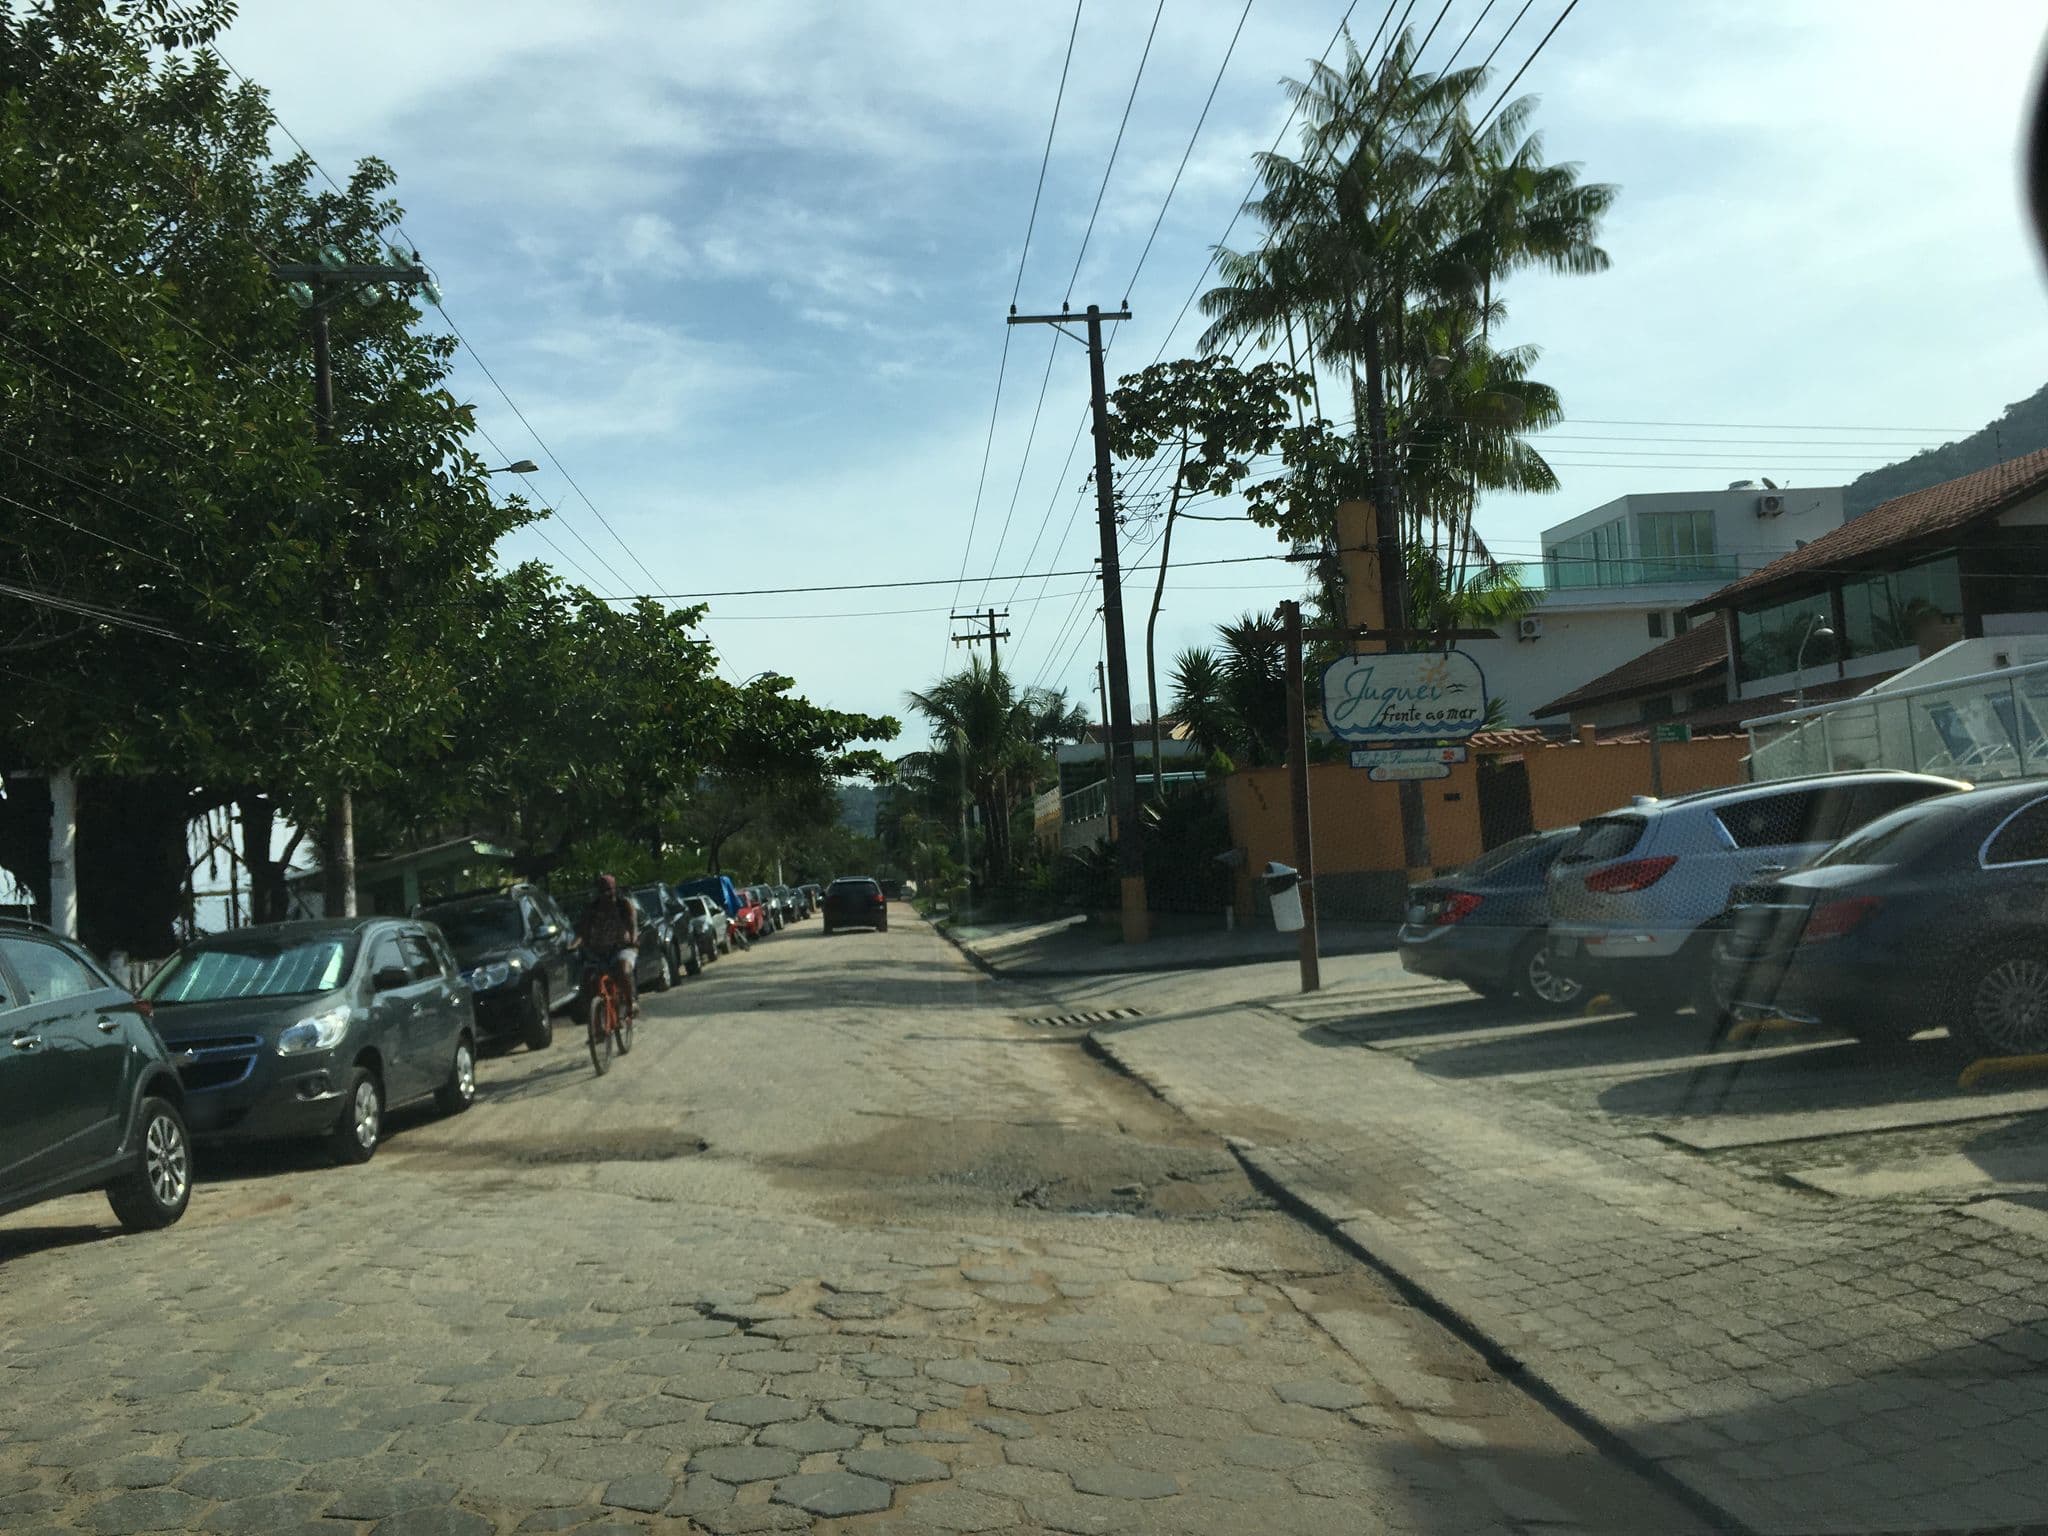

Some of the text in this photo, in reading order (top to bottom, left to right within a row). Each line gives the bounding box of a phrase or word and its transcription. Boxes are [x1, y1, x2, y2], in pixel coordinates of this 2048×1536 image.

[1380, 703, 1477, 724] frente ao mar
